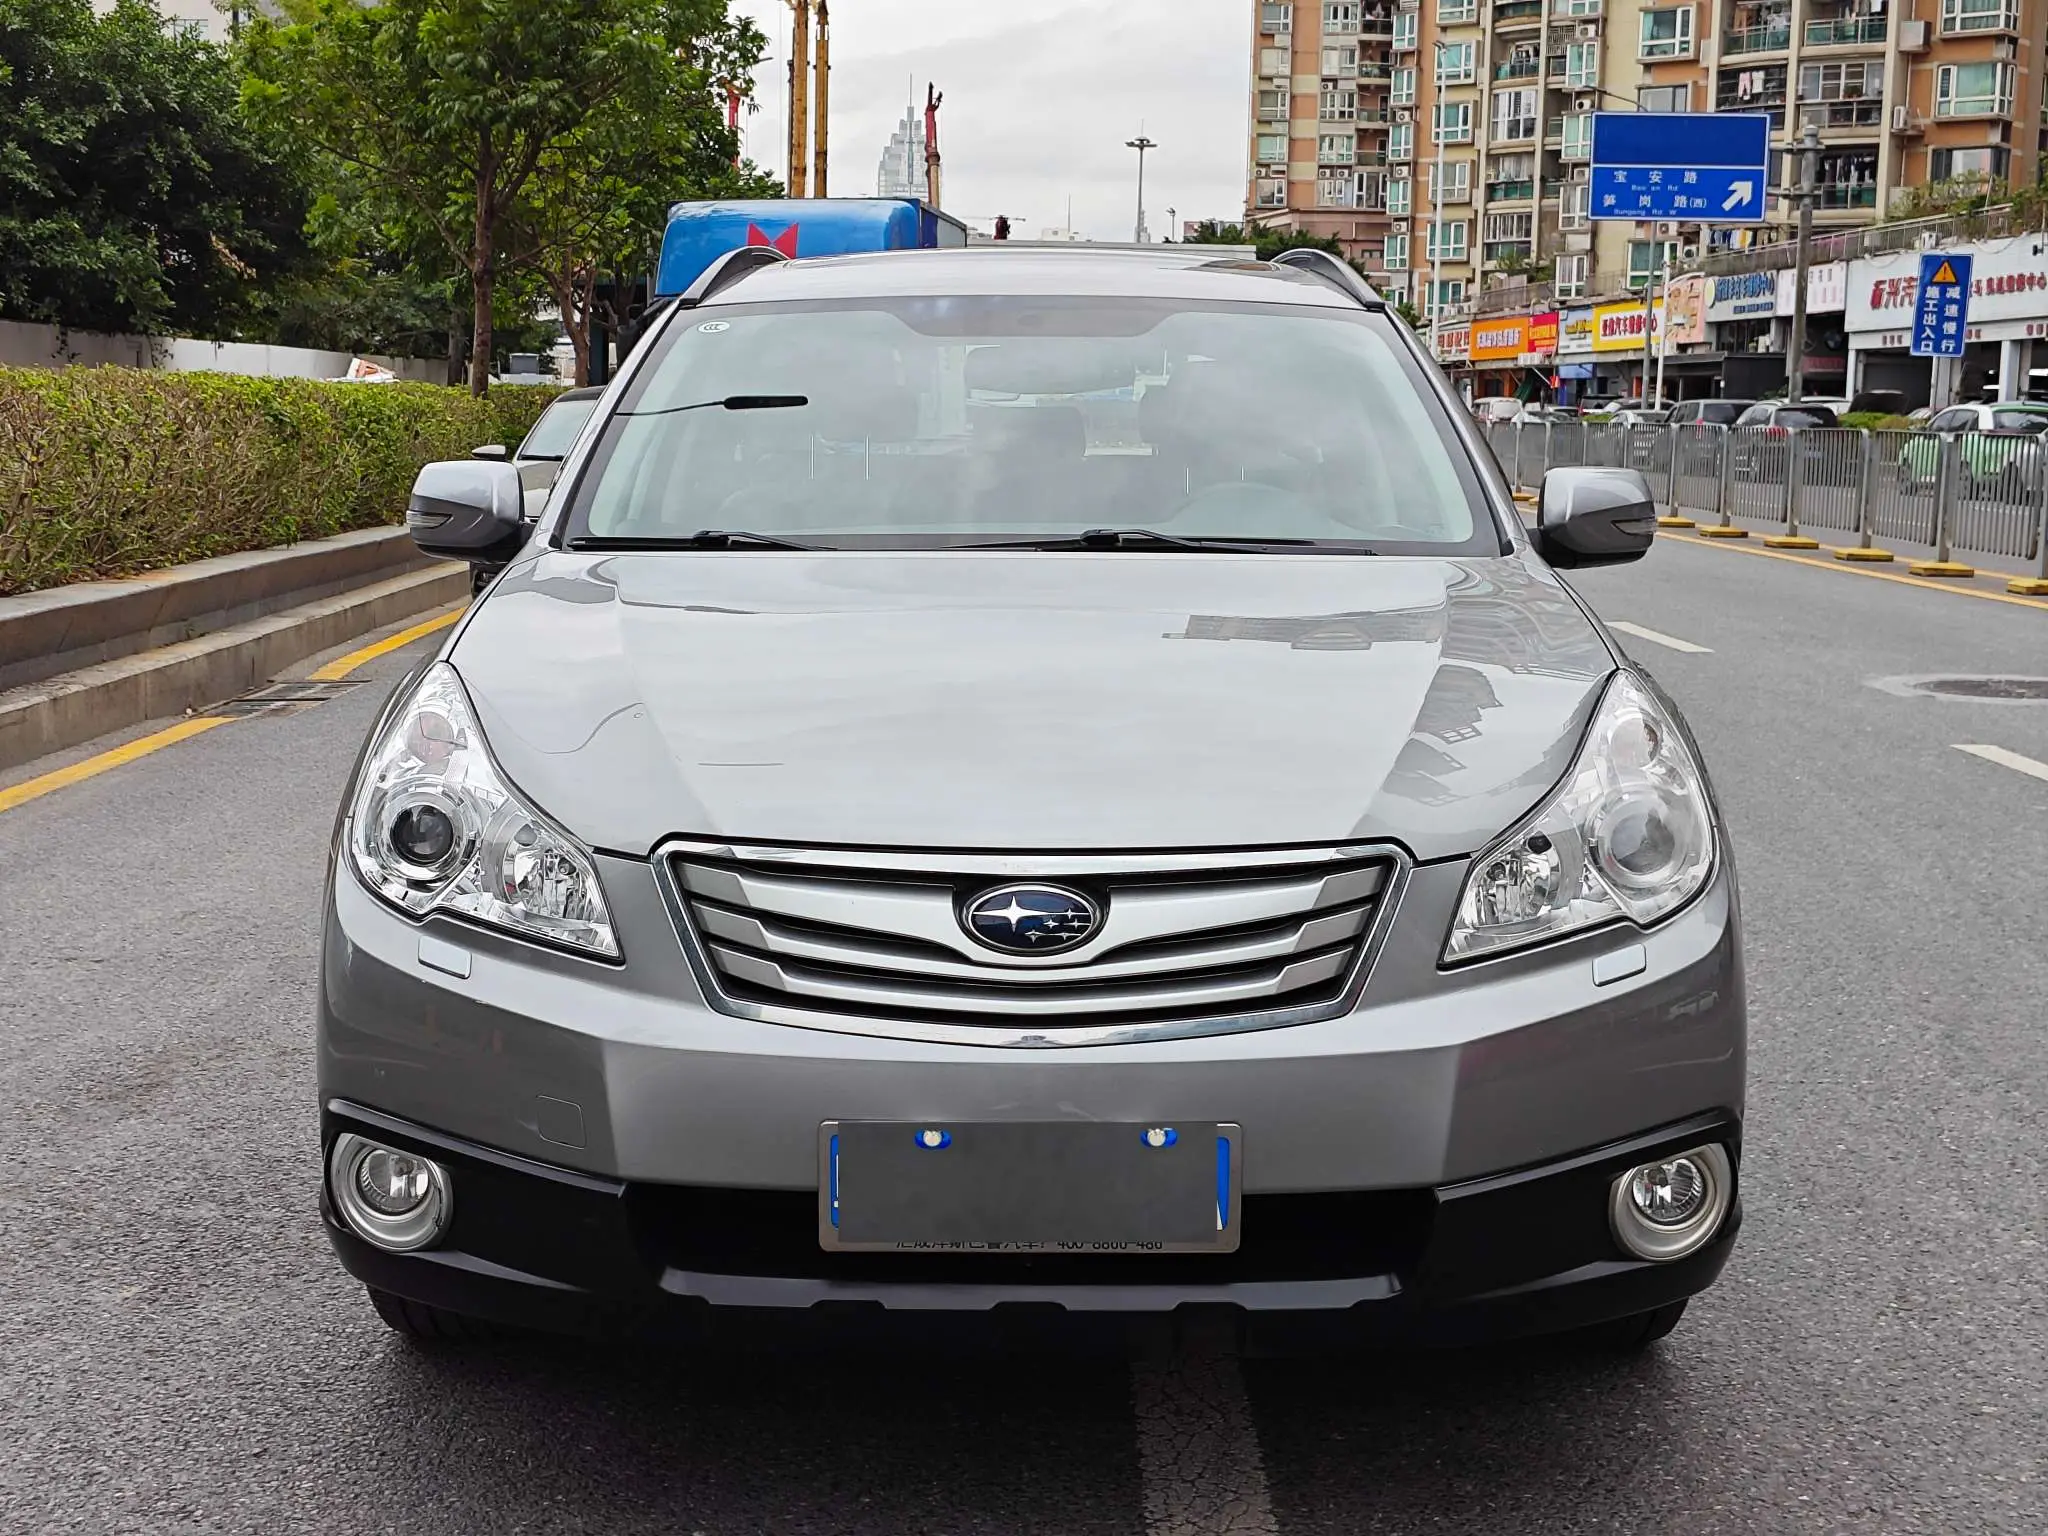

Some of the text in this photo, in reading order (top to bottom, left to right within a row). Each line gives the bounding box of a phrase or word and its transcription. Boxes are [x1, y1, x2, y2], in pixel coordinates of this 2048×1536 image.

[1614, 170, 1698, 184] 宝安路
[1920, 286, 1940, 352] 施工出入口
[1941, 286, 1961, 352] 减速慢行
